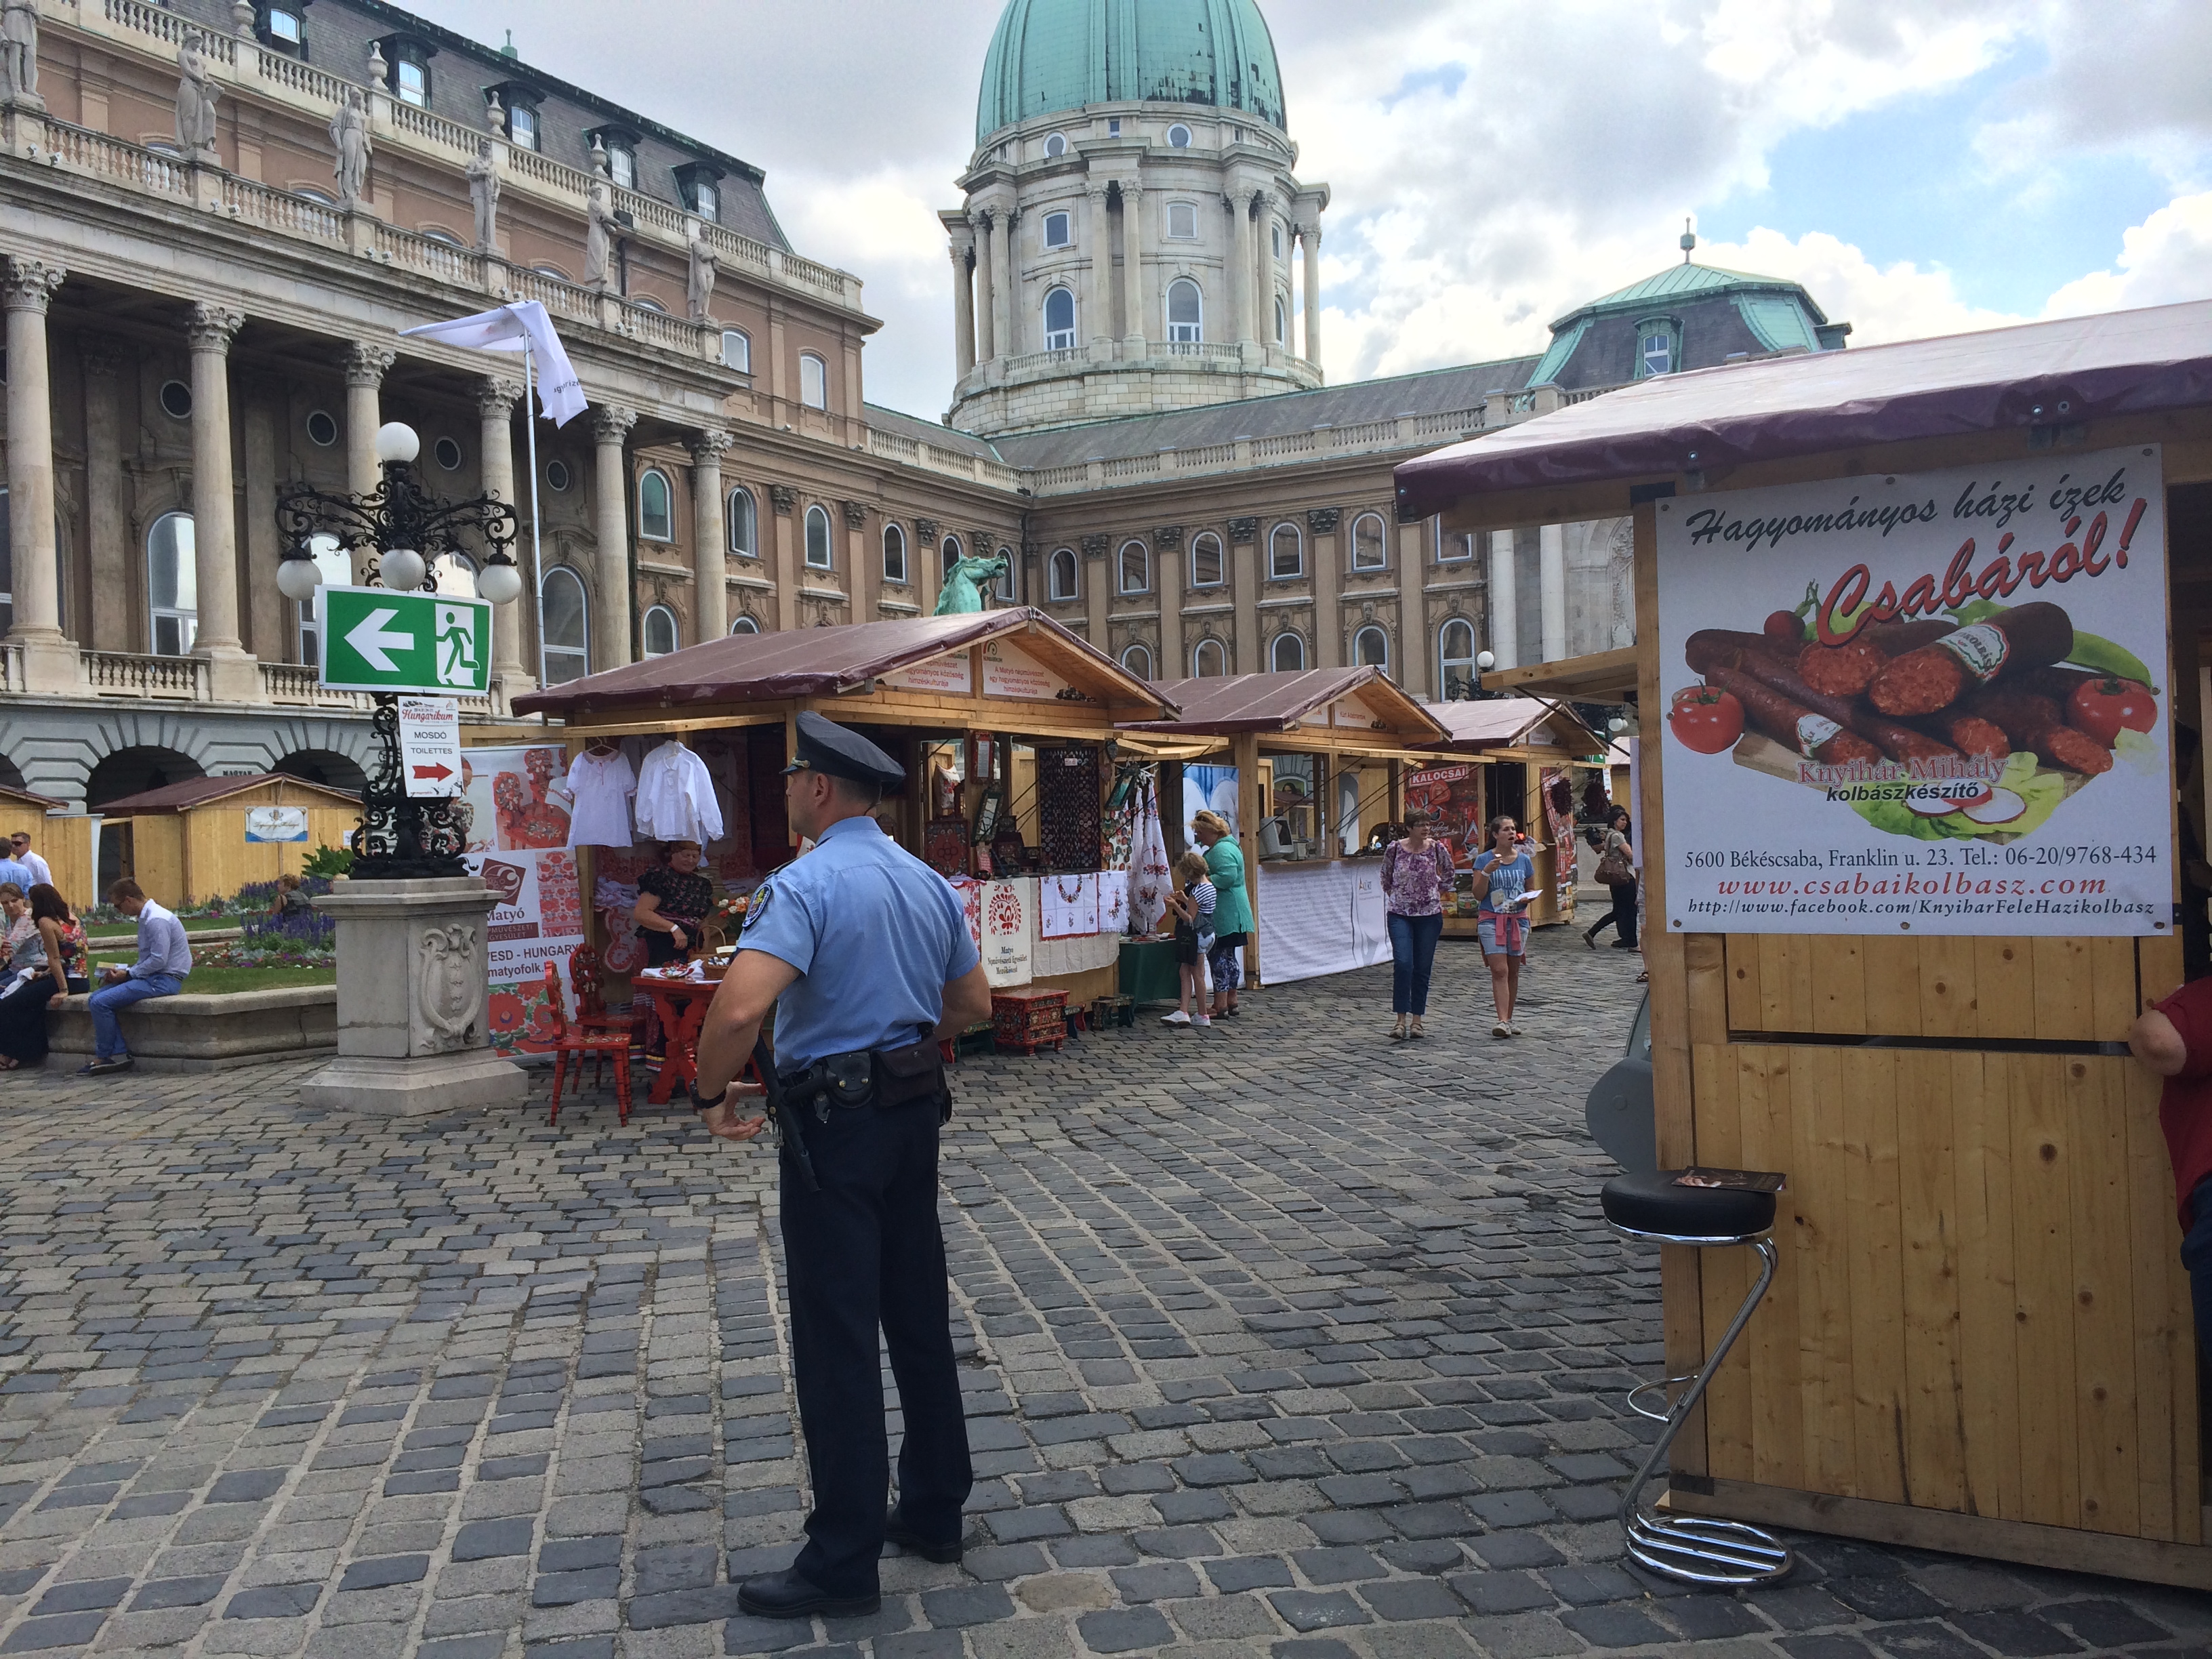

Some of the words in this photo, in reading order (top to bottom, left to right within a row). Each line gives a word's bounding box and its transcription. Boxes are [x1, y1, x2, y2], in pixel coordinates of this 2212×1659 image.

[1685, 495, 1938, 552] Hagyományos
[1952, 480, 2035, 529] házi
[2049, 467, 2126, 523] ízek
[1816, 498, 2148, 649] Csabáról!
[402, 709, 453, 723] Hungarikum
[414, 731, 447, 739] MOSDÓ
[1412, 768, 1466, 783] KALOCSAI
[1798, 757, 1904, 787] Knyihár
[1909, 754, 2009, 785] Mihály
[1826, 781, 1979, 802] kolbászkészítő
[1684, 851, 1725, 868] 5600
[1729, 849, 1823, 871] Békéscsaba,
[1828, 848, 1899, 867] Franklin
[1904, 854, 1920, 866] u.
[1926, 848, 1954, 866] 23.
[1959, 847, 1998, 865] Tel.:
[2005, 846, 2157, 866] 06-20/9768-434
[1717, 872, 2106, 895] www.csabaikolbasz.com
[1687, 898, 2155, 917] http://www.facebook.com/KnyiharFeleHazikolbasz
[488, 932, 526, 941] GYESÜLET
[487, 950, 514, 962] ESD
[523, 943, 579, 959] HUNGARY
[488, 963, 544, 978] matyofolk.
